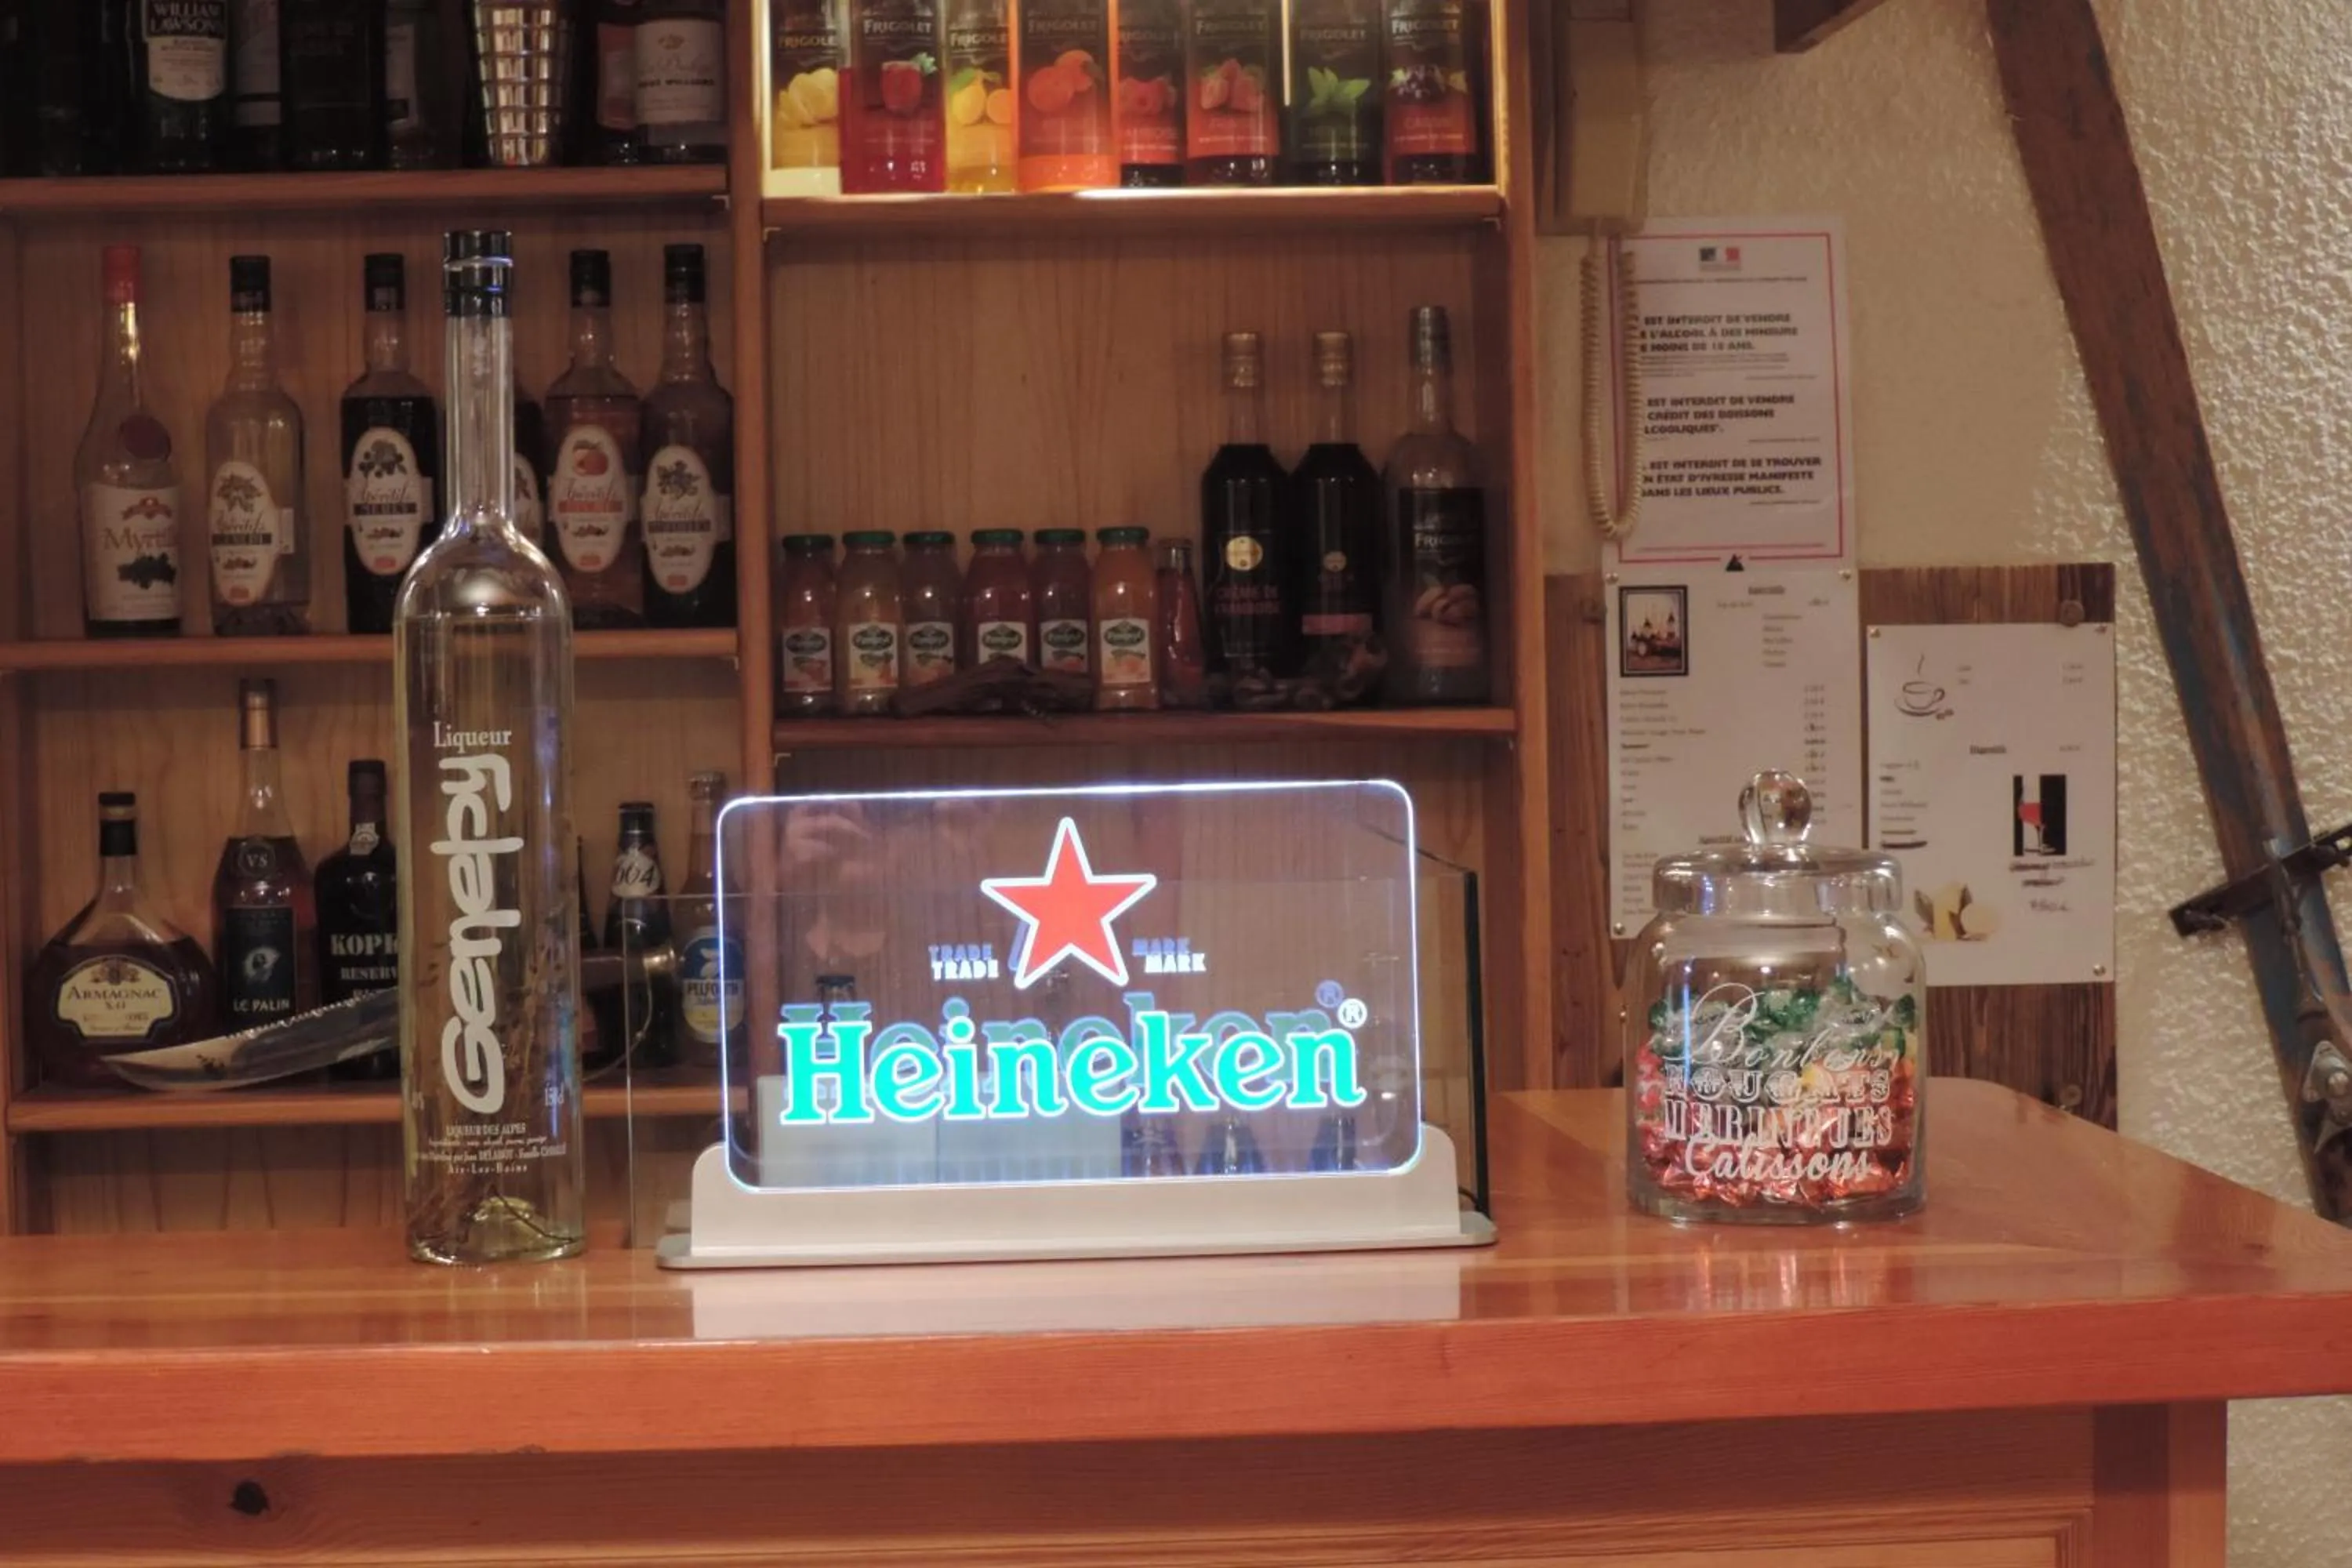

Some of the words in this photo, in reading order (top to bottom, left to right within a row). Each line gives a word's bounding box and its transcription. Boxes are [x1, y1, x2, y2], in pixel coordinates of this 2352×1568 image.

[864, 18, 933, 34] FRIGOLET
[778, 34, 837, 49] FRIGOLE
[949, 32, 1008, 47] FRIGOLE
[1647, 397, 1666, 407] EST
[1670, 396, 1726, 406] INTERDIT
[1729, 395, 1744, 405] DE
[1747, 394, 1795, 405] VENDRE
[1693, 410, 1715, 420] DES
[1718, 408, 1775, 419] BOISSONS
[1650, 460, 1668, 470] EST
[1672, 459, 1729, 470] INTERDIT
[1732, 458, 1747, 468] DE
[1766, 456, 1822, 467] TROUVER
[1748, 470, 1815, 481] MANIFESTE
[1674, 487, 1693, 497] LES
[434, 722, 512, 753] Liqueur
[330, 933, 398, 956] KOPK
[339, 966, 397, 981] RESERV
[931, 958, 1000, 981] TRADE
[1145, 953, 1207, 973] MARK
[67, 985, 161, 1001] ARMAGNAC
[778, 1011, 1367, 1126] Heineken
[1685, 1134, 1873, 1181] Calissons
